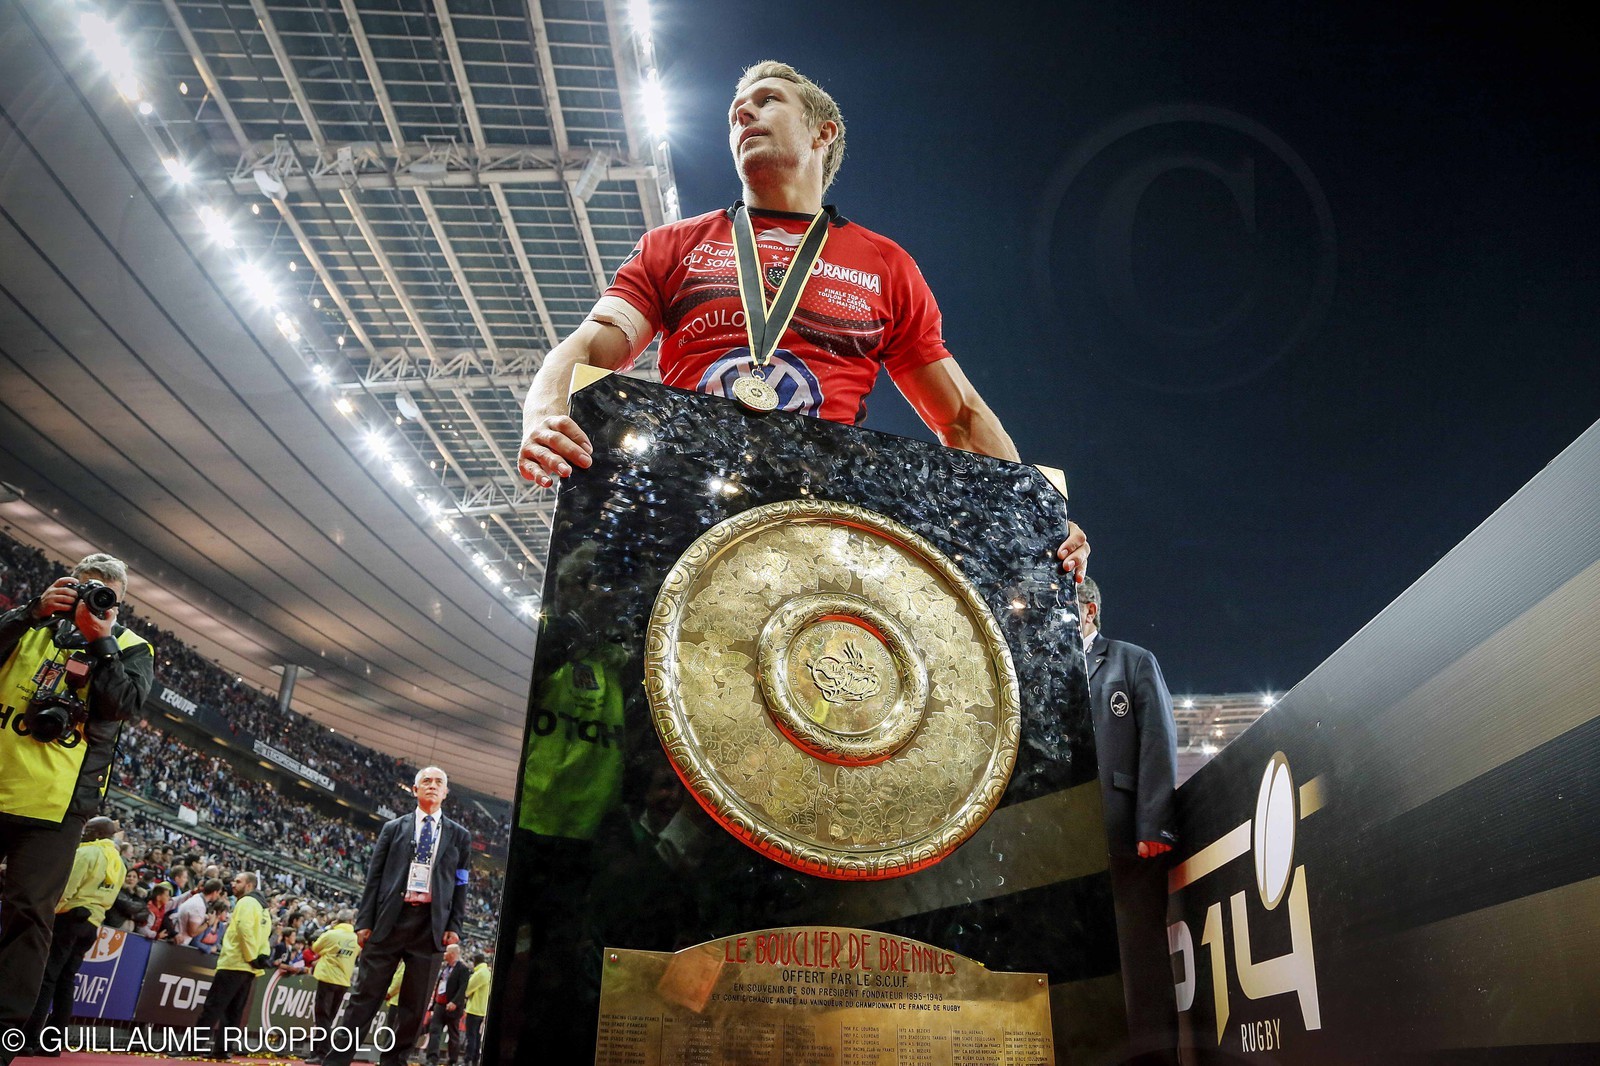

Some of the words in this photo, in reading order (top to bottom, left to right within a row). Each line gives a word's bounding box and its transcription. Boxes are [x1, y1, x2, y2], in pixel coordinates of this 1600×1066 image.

[757, 243, 783, 251] URRDA
[683, 253, 703, 266] du
[704, 257, 738, 268] sole
[811, 256, 881, 295] ORANGINA
[818, 291, 842, 303] TOULON
[846, 298, 871, 312] CASTRES
[824, 288, 847, 298] FINALE
[847, 293, 859, 301] TOP
[836, 299, 848, 307] MAI
[682, 309, 747, 338] TOULO
[725, 937, 748, 964] LE
[755, 931, 841, 969] BOUCLIER
[848, 932, 872, 971] DE
[879, 937, 956, 975] BRENNUS
[782, 969, 825, 984] OFFERT
[831, 973, 852, 985] PAR
[856, 973, 870, 987] LE
[875, 975, 909, 988] S.C.U.F.
[733, 983, 744, 991] EN
[747, 984, 785, 994] SOUVENIR
[787, 986, 797, 994] DE
[800, 987, 816, 996] SON
[861, 991, 903, 1000] FONDATEUR
[906, 992, 943, 1002] 1895-1943
[749, 995, 773, 1004] CHAQUE
[810, 999, 843, 1008] VAINQUEUR
[856, 1001, 896, 1009] CHAMPIONNAT
[908, 1003, 931, 1011] FRANCE
[1241, 1018, 1281, 1052] RUGBY
